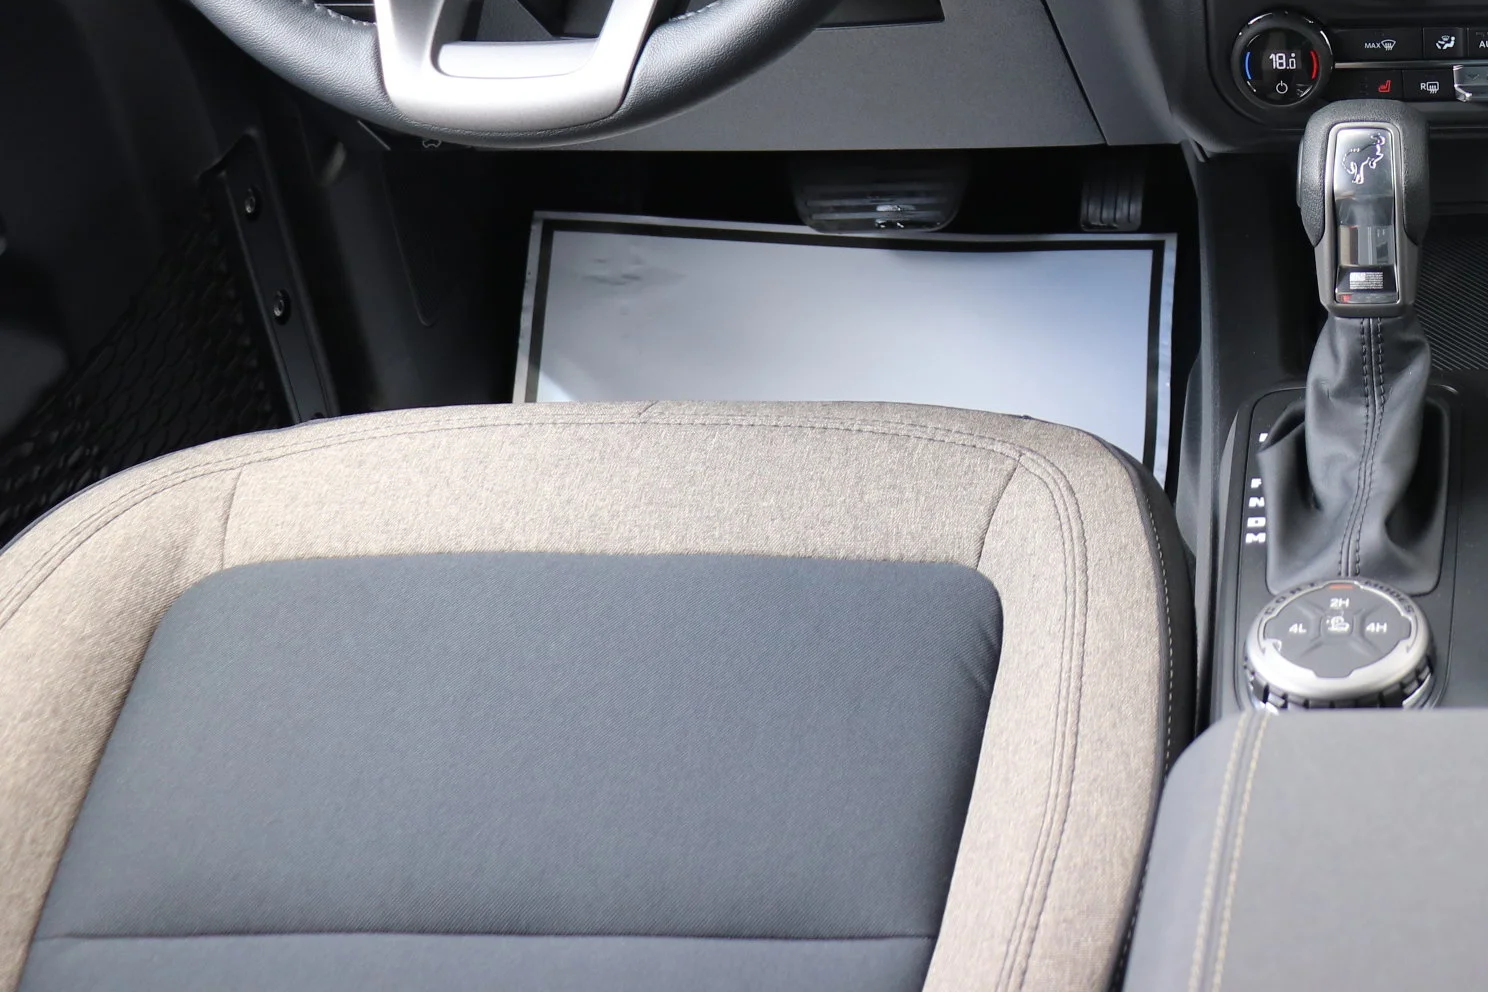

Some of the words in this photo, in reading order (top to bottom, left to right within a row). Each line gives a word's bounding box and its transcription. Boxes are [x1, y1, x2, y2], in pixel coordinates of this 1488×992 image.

[1364, 41, 1381, 49] MAX
[1248, 496, 1266, 508] N
[1246, 516, 1267, 528] D
[1245, 532, 1267, 544] M
[1329, 597, 1350, 608] 2H
[1288, 622, 1307, 634] 4L
[1366, 621, 1388, 634] 4H
